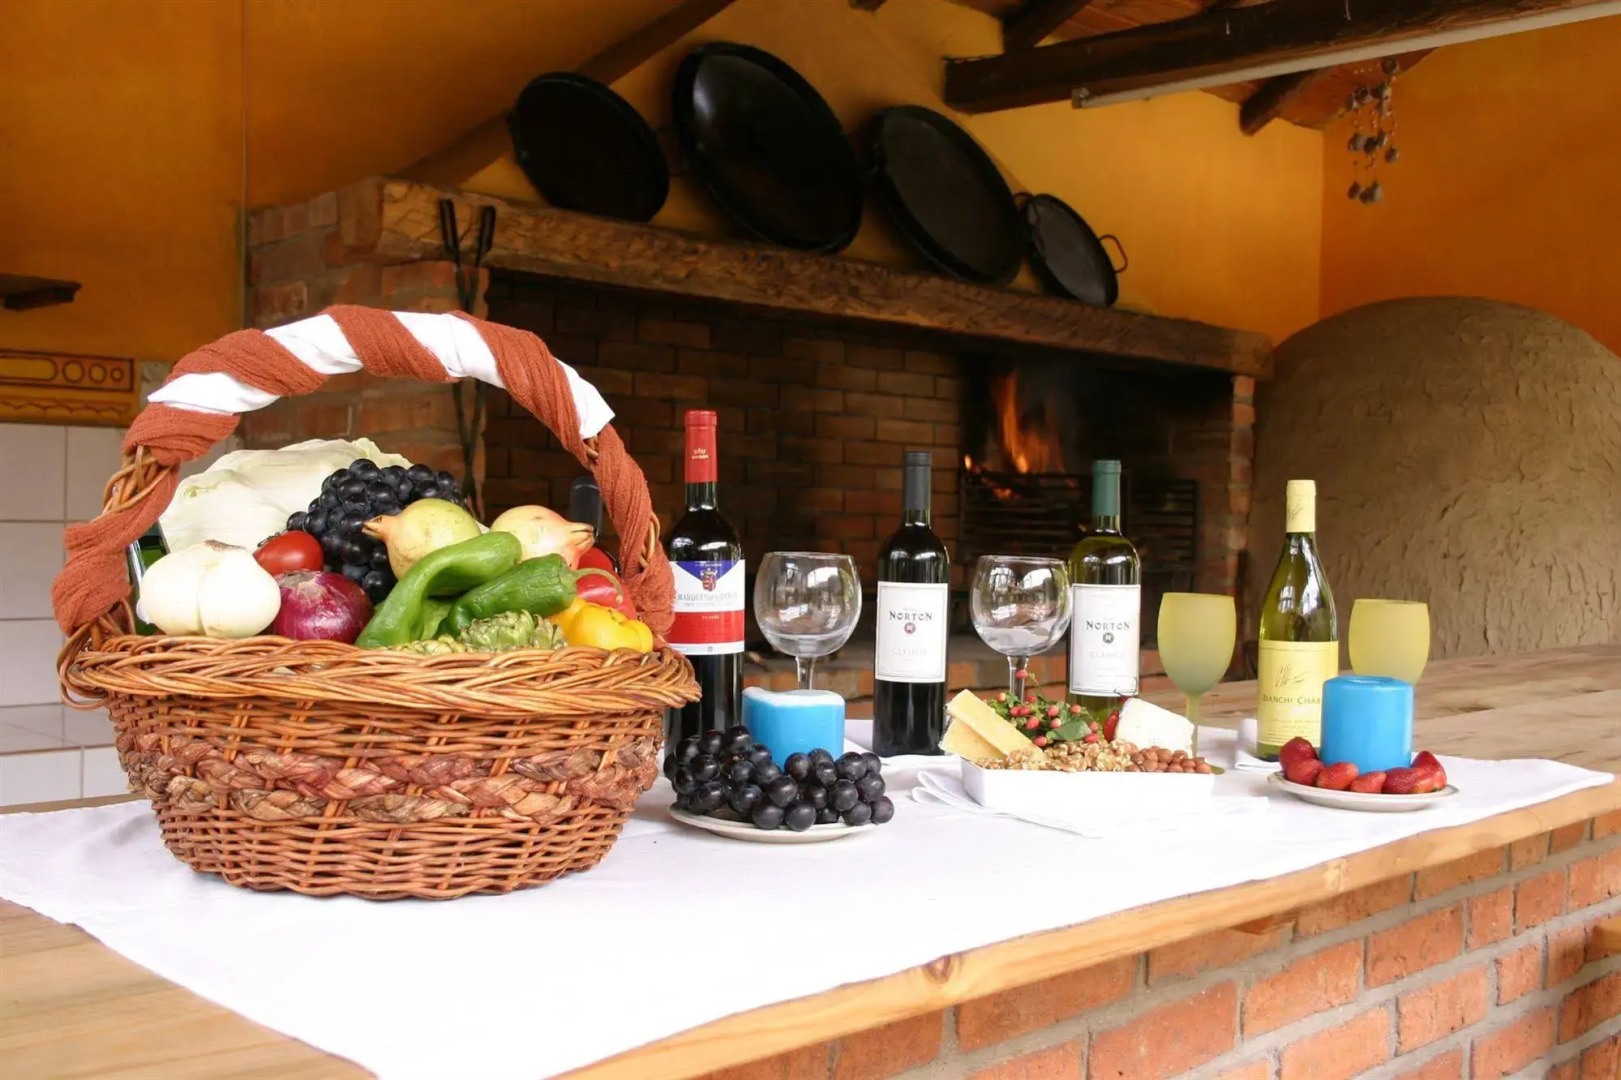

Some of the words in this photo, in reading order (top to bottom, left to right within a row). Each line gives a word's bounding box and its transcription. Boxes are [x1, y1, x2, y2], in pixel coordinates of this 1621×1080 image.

[889, 610, 933, 621] NORTON
[1086, 620, 1130, 631] NORTON
[1262, 693, 1293, 704] BIANCHI
[1297, 696, 1321, 705] CHAB
